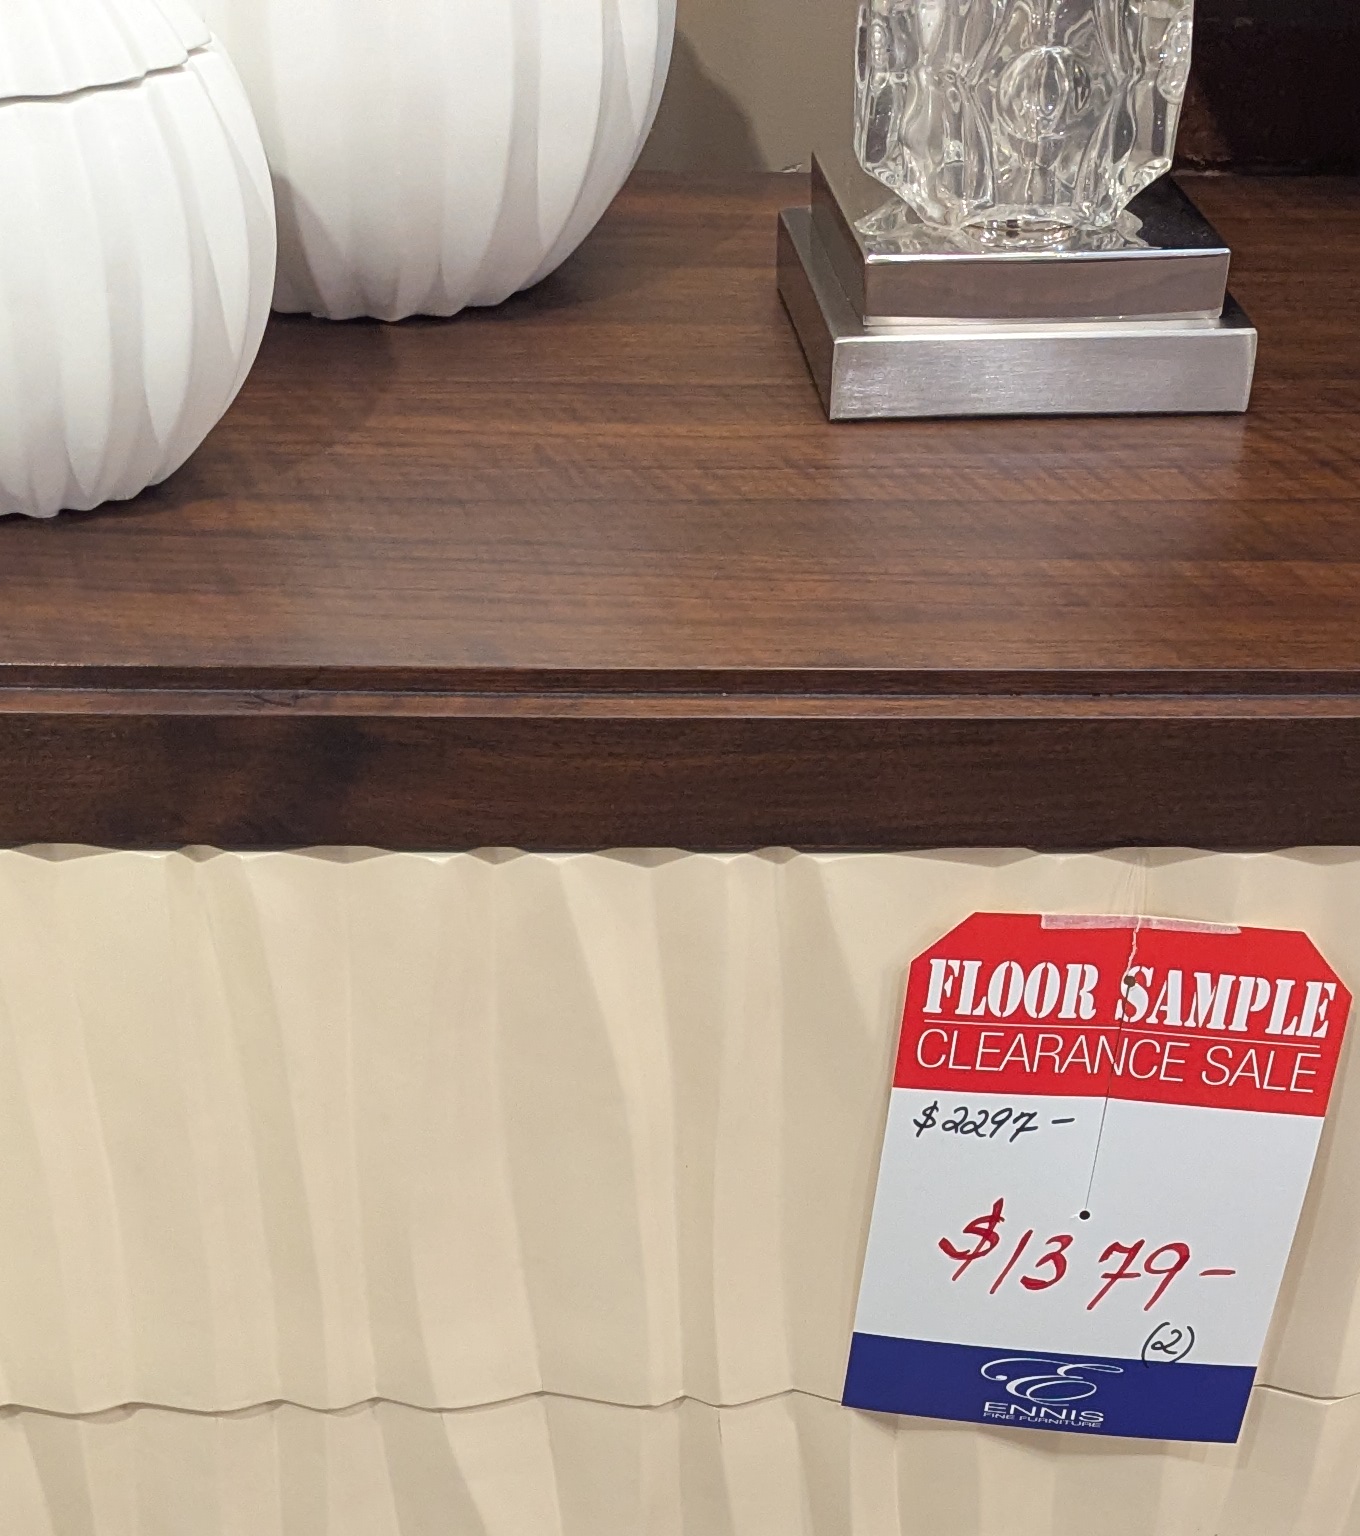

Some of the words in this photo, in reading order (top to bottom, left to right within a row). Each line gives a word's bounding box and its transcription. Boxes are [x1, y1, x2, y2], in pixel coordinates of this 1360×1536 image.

[922, 958, 1100, 1021] FLOOR
[1115, 965, 1338, 1039] SAMPLE
[916, 1028, 1190, 1083] CLEARANCE
[1201, 1045, 1321, 1093] SALE
[1141, 1322, 1195, 1368] (2)
[982, 1411, 1015, 1421] FINE
[1018, 1415, 1102, 1429] FURNITURE
[983, 1401, 1104, 1423] ENNIS
